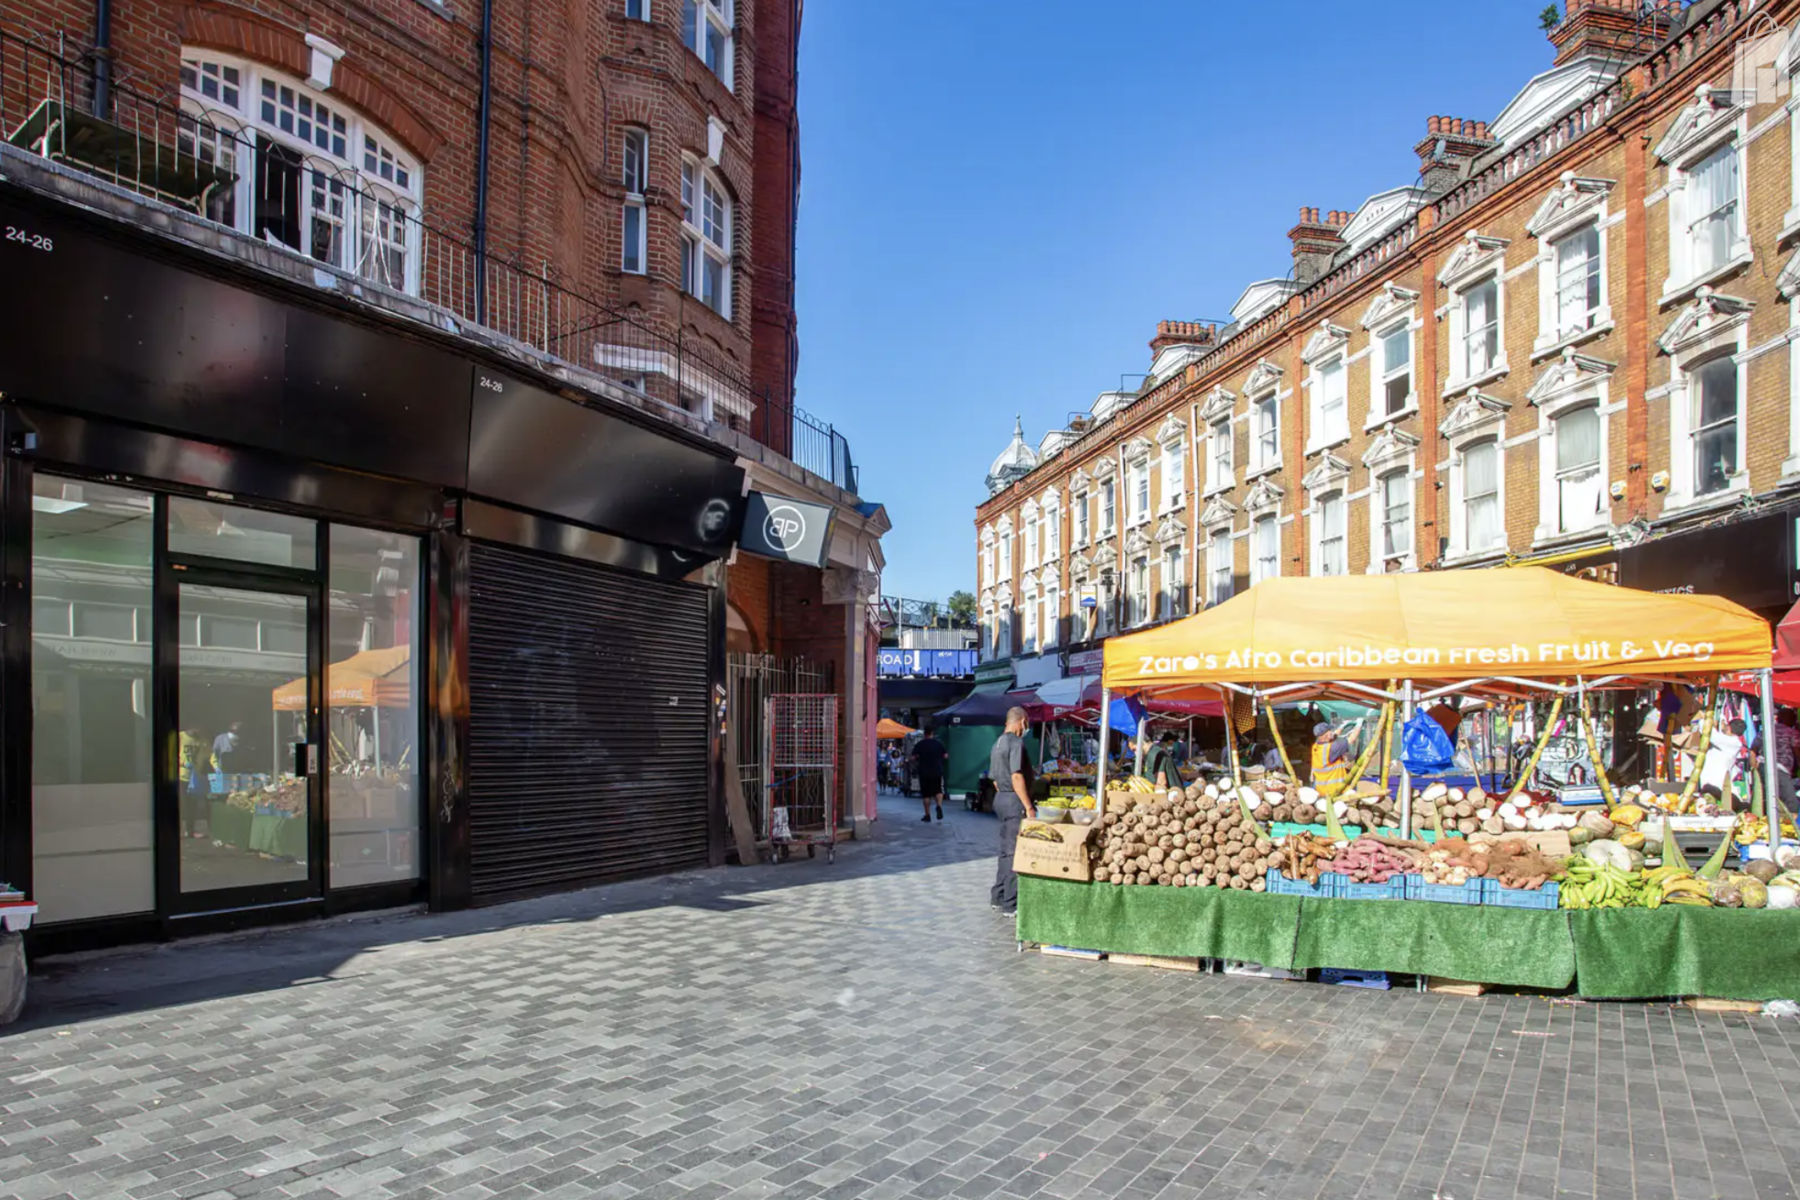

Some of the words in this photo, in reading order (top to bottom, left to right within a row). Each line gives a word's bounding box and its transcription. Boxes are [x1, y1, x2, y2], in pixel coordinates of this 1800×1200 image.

[5, 225, 53, 251] 24-26
[480, 376, 503, 392] 24-26
[1225, 647, 1281, 669] Afro
[1290, 646, 1439, 667] Caribbean
[1449, 643, 1529, 664] Fresh
[1538, 640, 1611, 661] Fruit
[1620, 640, 1643, 659] &
[1652, 640, 1714, 661] Veg
